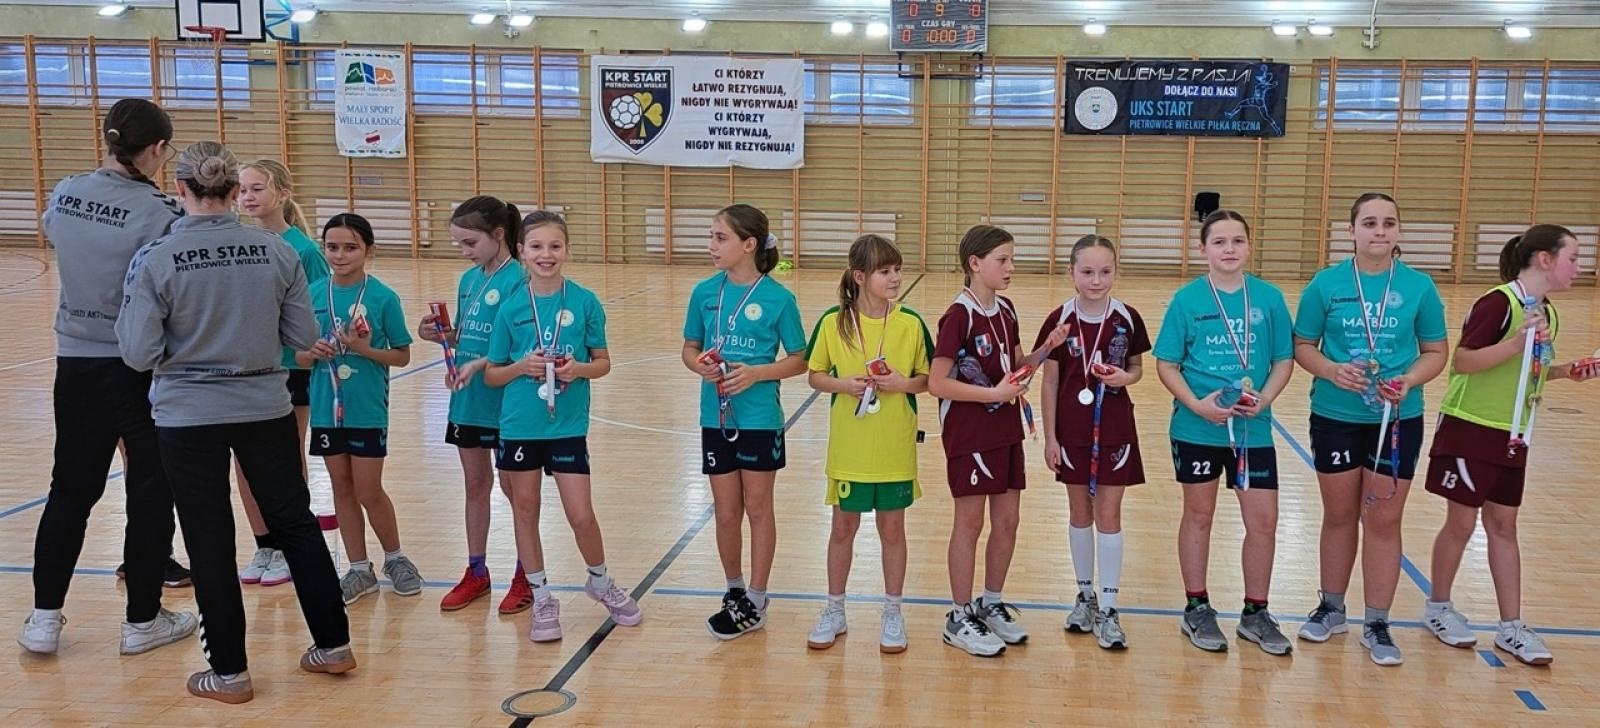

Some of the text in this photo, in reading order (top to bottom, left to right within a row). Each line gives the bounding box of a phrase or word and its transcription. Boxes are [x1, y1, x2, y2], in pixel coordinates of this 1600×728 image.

[604, 71, 668, 82] KPR START
[714, 67, 765, 79] CI KTÓRZY
[1074, 67, 1174, 81] TRENUJEMY
[1177, 68, 1190, 81] Z
[692, 83, 787, 96] ŁATWO REZYGNUJĄ,
[1164, 85, 1200, 97] DOŁĄCZ
[1201, 86, 1214, 96] DO
[369, 105, 395, 115] SPORT
[681, 97, 799, 110] NIGDY NIE WYGRYWAJĄ!
[1130, 100, 1194, 116] UKS START
[339, 116, 369, 125] WIELKA
[714, 110, 765, 123] CI KTÓRZY
[708, 126, 772, 139] WYGRYWAJĄ,
[1129, 119, 1261, 132] PIETROWICE WIELKIE PIŁKA RĘCZNA
[685, 140, 795, 155] NIGDY NIE REZYGNUJĄ!
[57, 194, 131, 220] KPR START
[95, 216, 126, 228] WIELKIE
[172, 245, 267, 265] KPR START
[175, 260, 231, 273] PIETROWICE
[1365, 302, 1381, 316] 21
[543, 325, 553, 341] 6
[320, 433, 331, 448] 3
[514, 446, 525, 462] 6
[707, 452, 716, 467] 5
[1331, 450, 1351, 465] 21
[1192, 461, 1211, 475] 22
[970, 469, 979, 486] 6
[1441, 470, 1459, 489] 13
